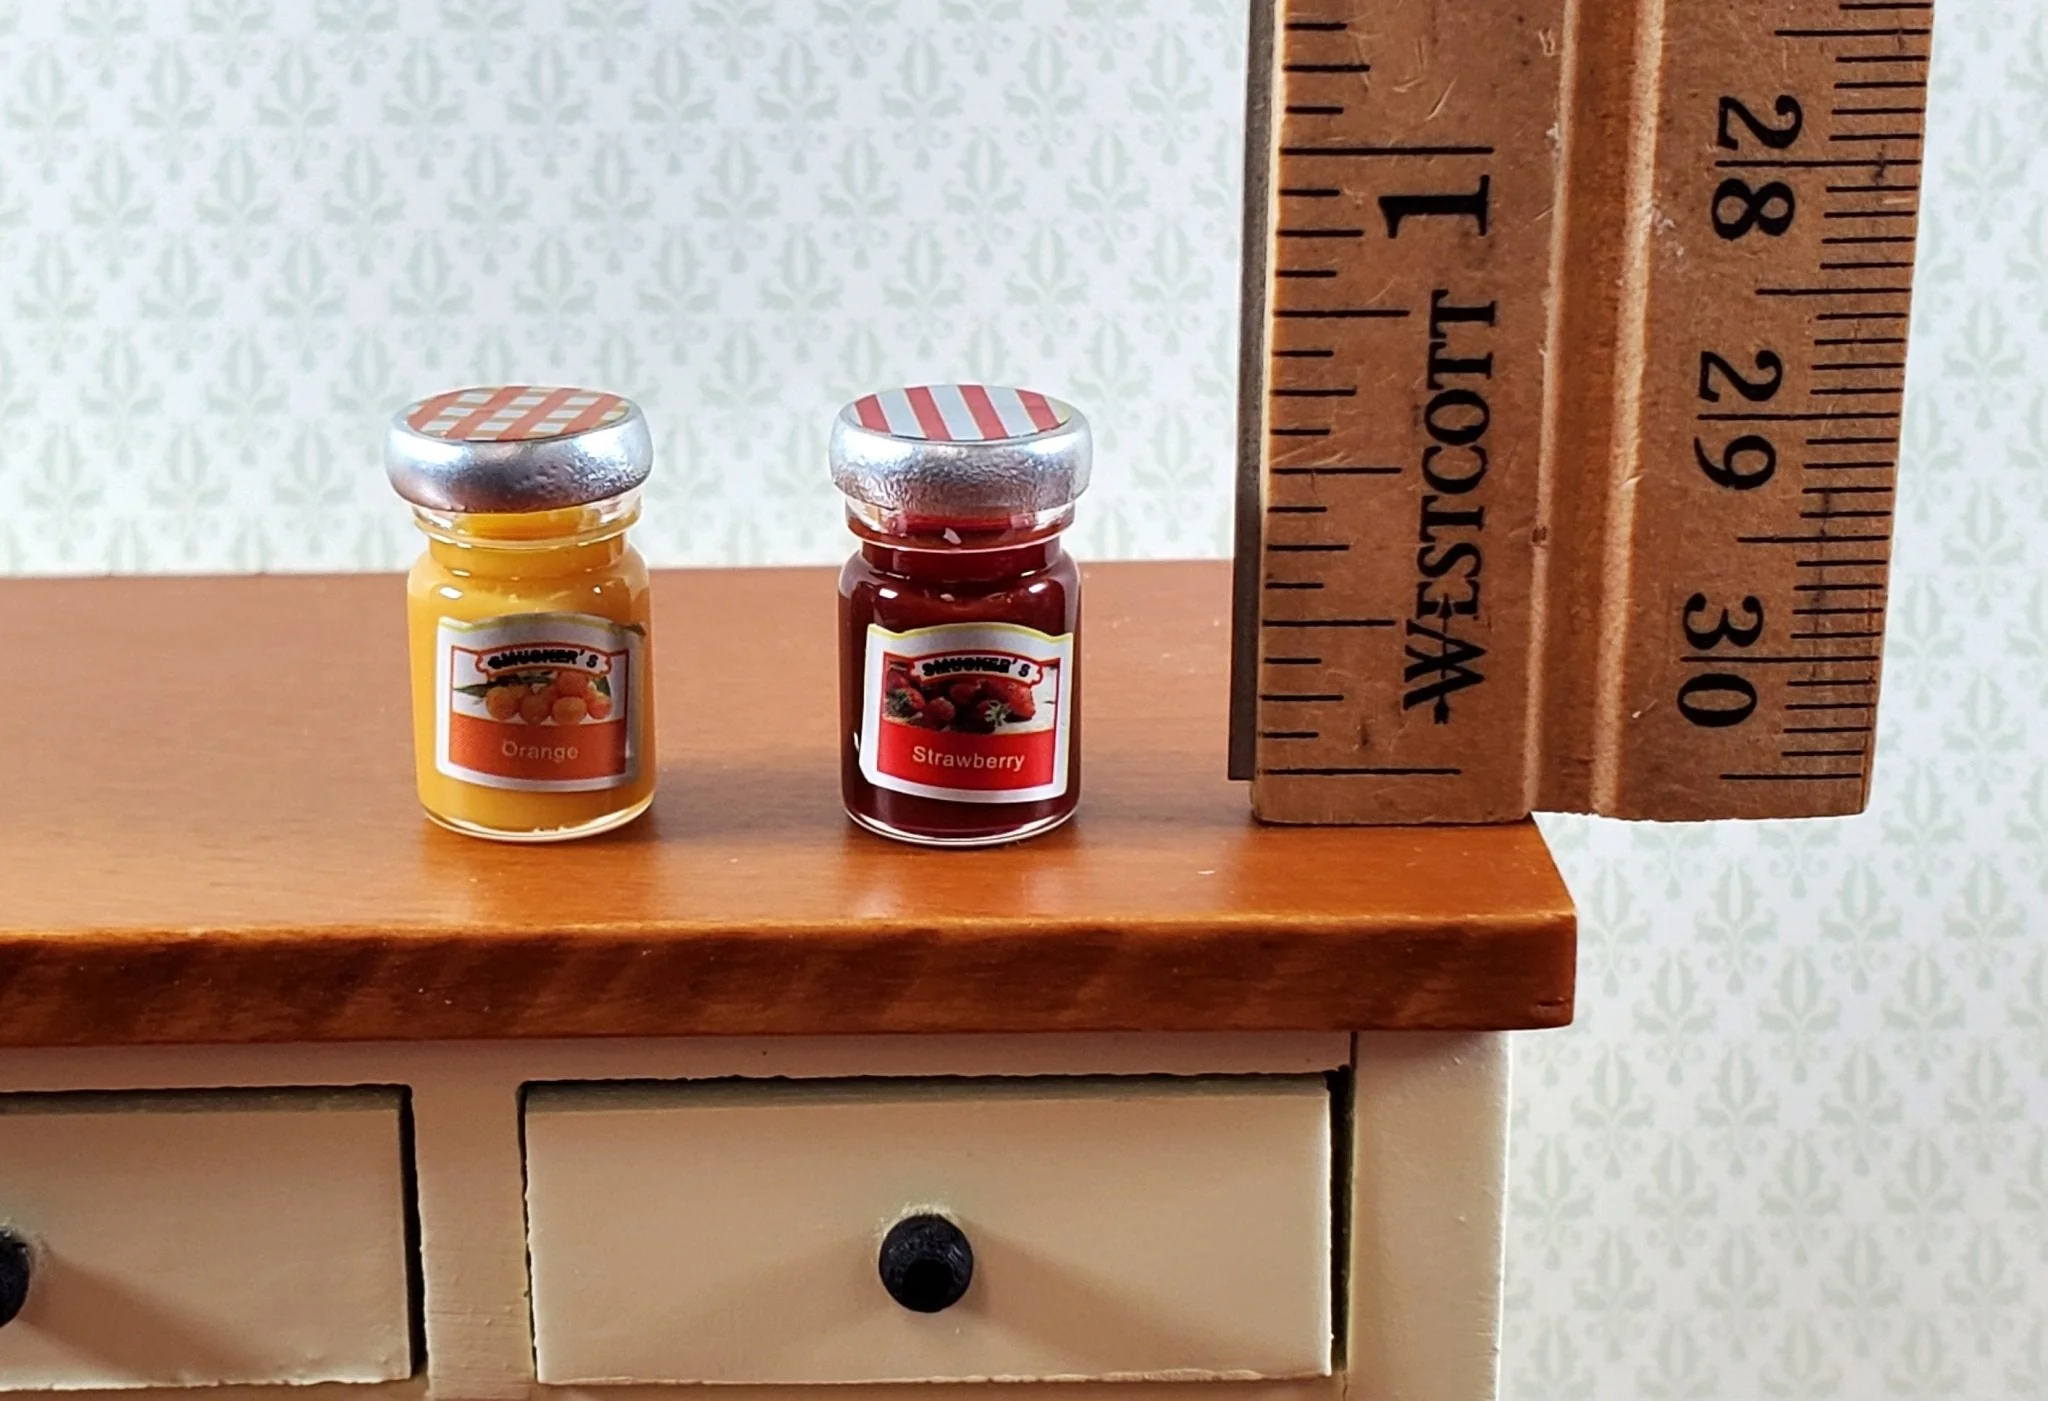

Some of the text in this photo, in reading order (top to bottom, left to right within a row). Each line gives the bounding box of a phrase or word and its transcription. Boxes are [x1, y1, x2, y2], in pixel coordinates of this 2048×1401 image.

[1378, 174, 1491, 239] 1
[1710, 94, 1803, 241] 28
[1694, 349, 1784, 490] 29
[1403, 288, 1497, 712] WESTCOTT
[1677, 591, 1764, 728] 30
[502, 739, 579, 763] Orange
[911, 745, 1025, 772] Strawberry
